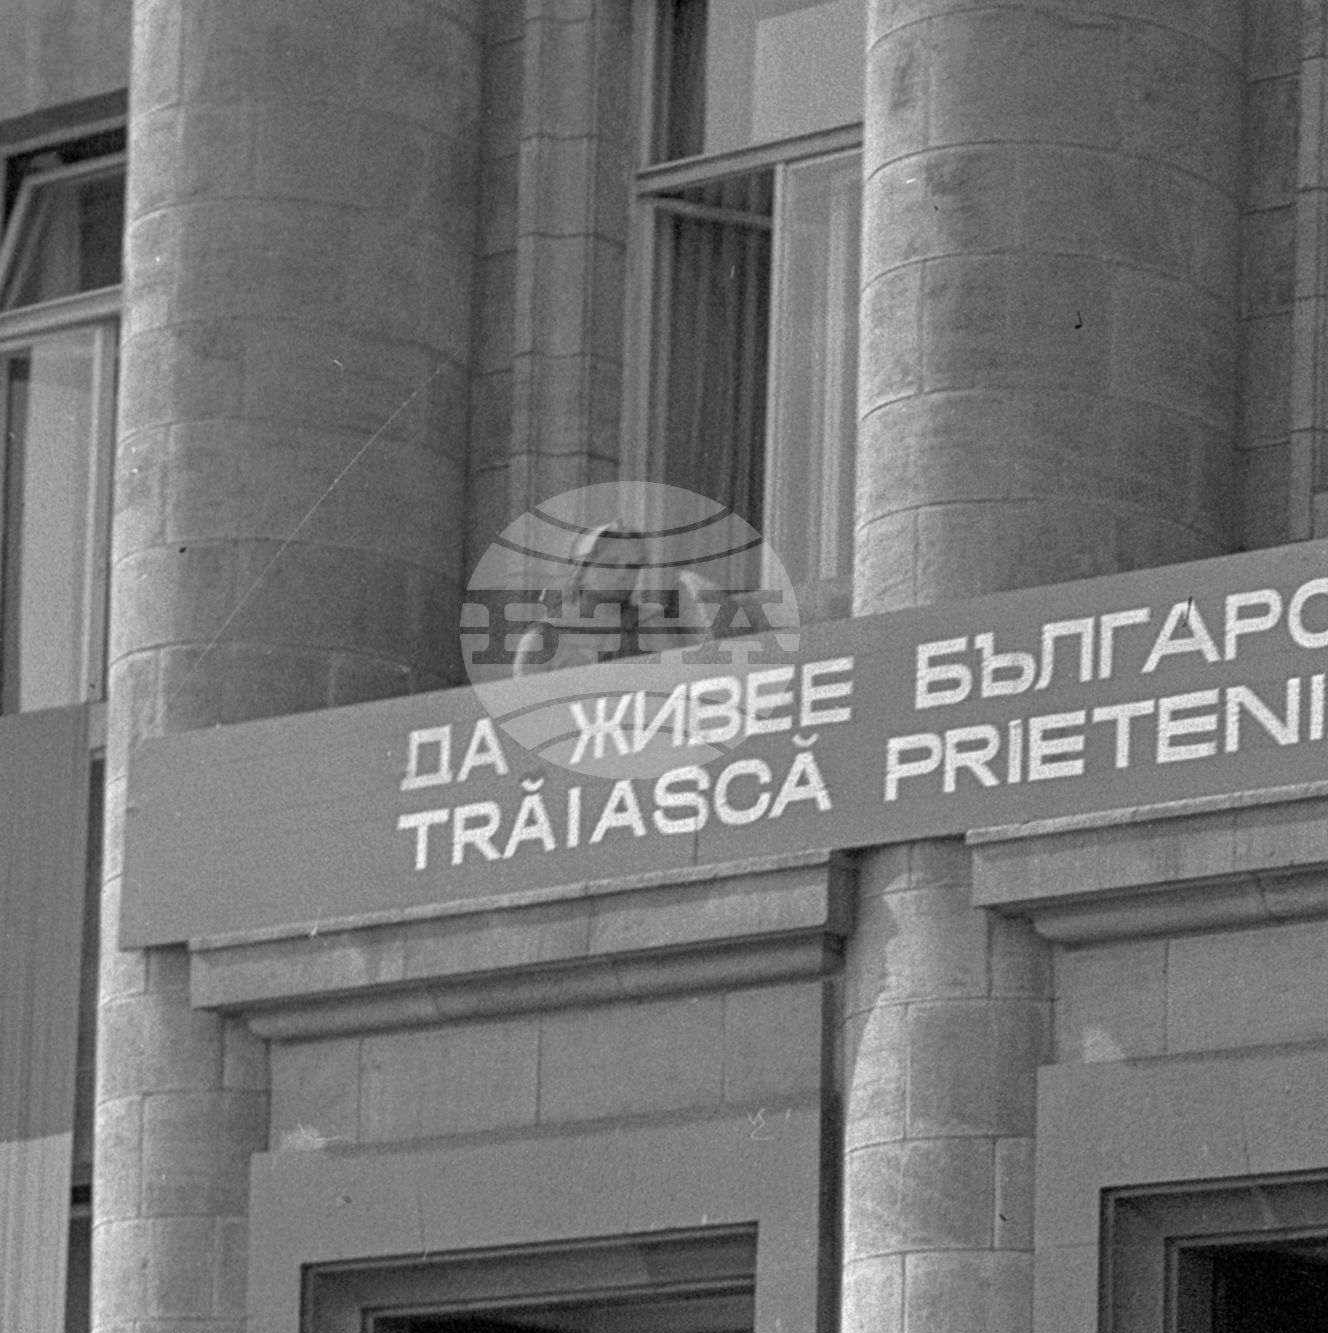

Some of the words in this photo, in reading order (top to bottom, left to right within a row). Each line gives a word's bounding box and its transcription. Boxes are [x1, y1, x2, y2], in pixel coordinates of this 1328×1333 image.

[399, 718, 509, 791] ДА
[569, 656, 855, 765] ЖИВЕЕ
[398, 733, 833, 870] TRĂIASCĂ
